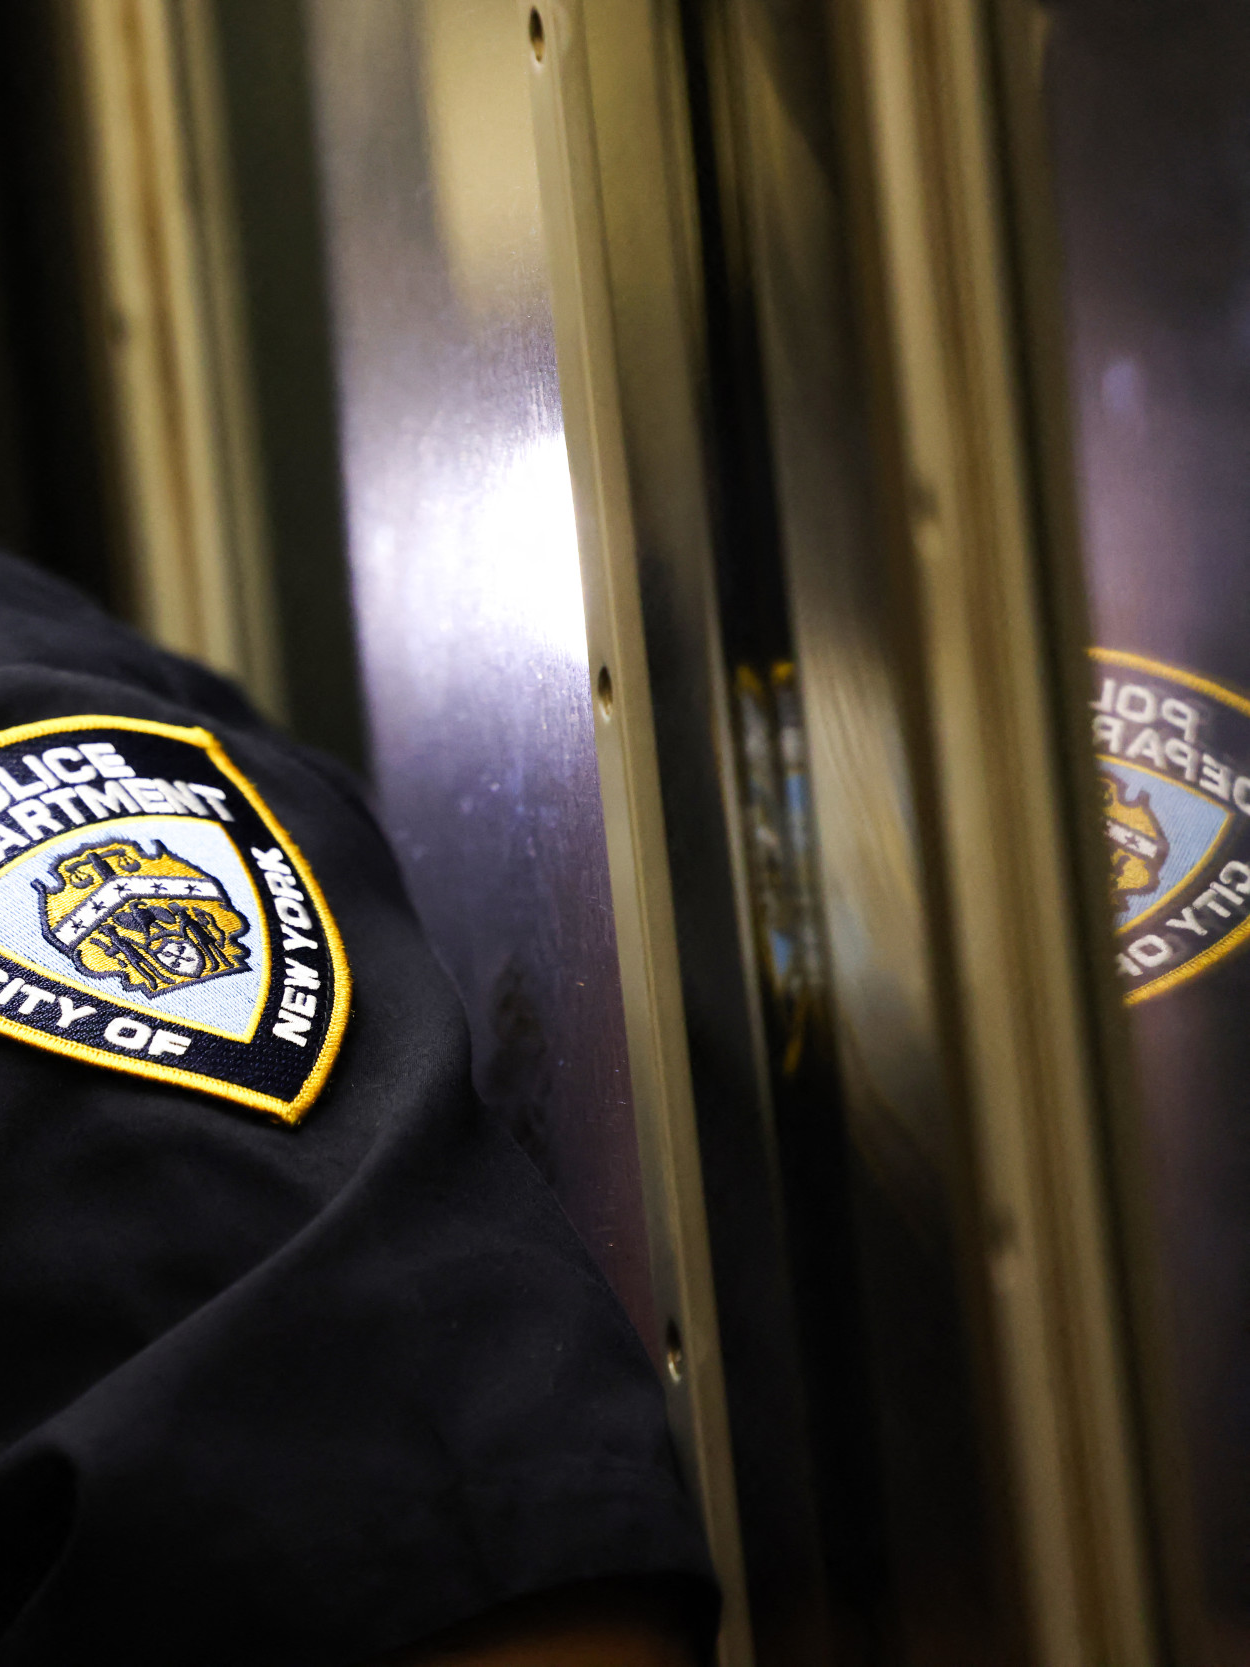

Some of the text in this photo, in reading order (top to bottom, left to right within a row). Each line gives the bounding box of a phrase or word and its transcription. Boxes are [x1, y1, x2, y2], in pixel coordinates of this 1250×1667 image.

[251, 846, 318, 952] YORK
[105, 1018, 192, 1057] OF
[272, 960, 321, 1047] NEW
